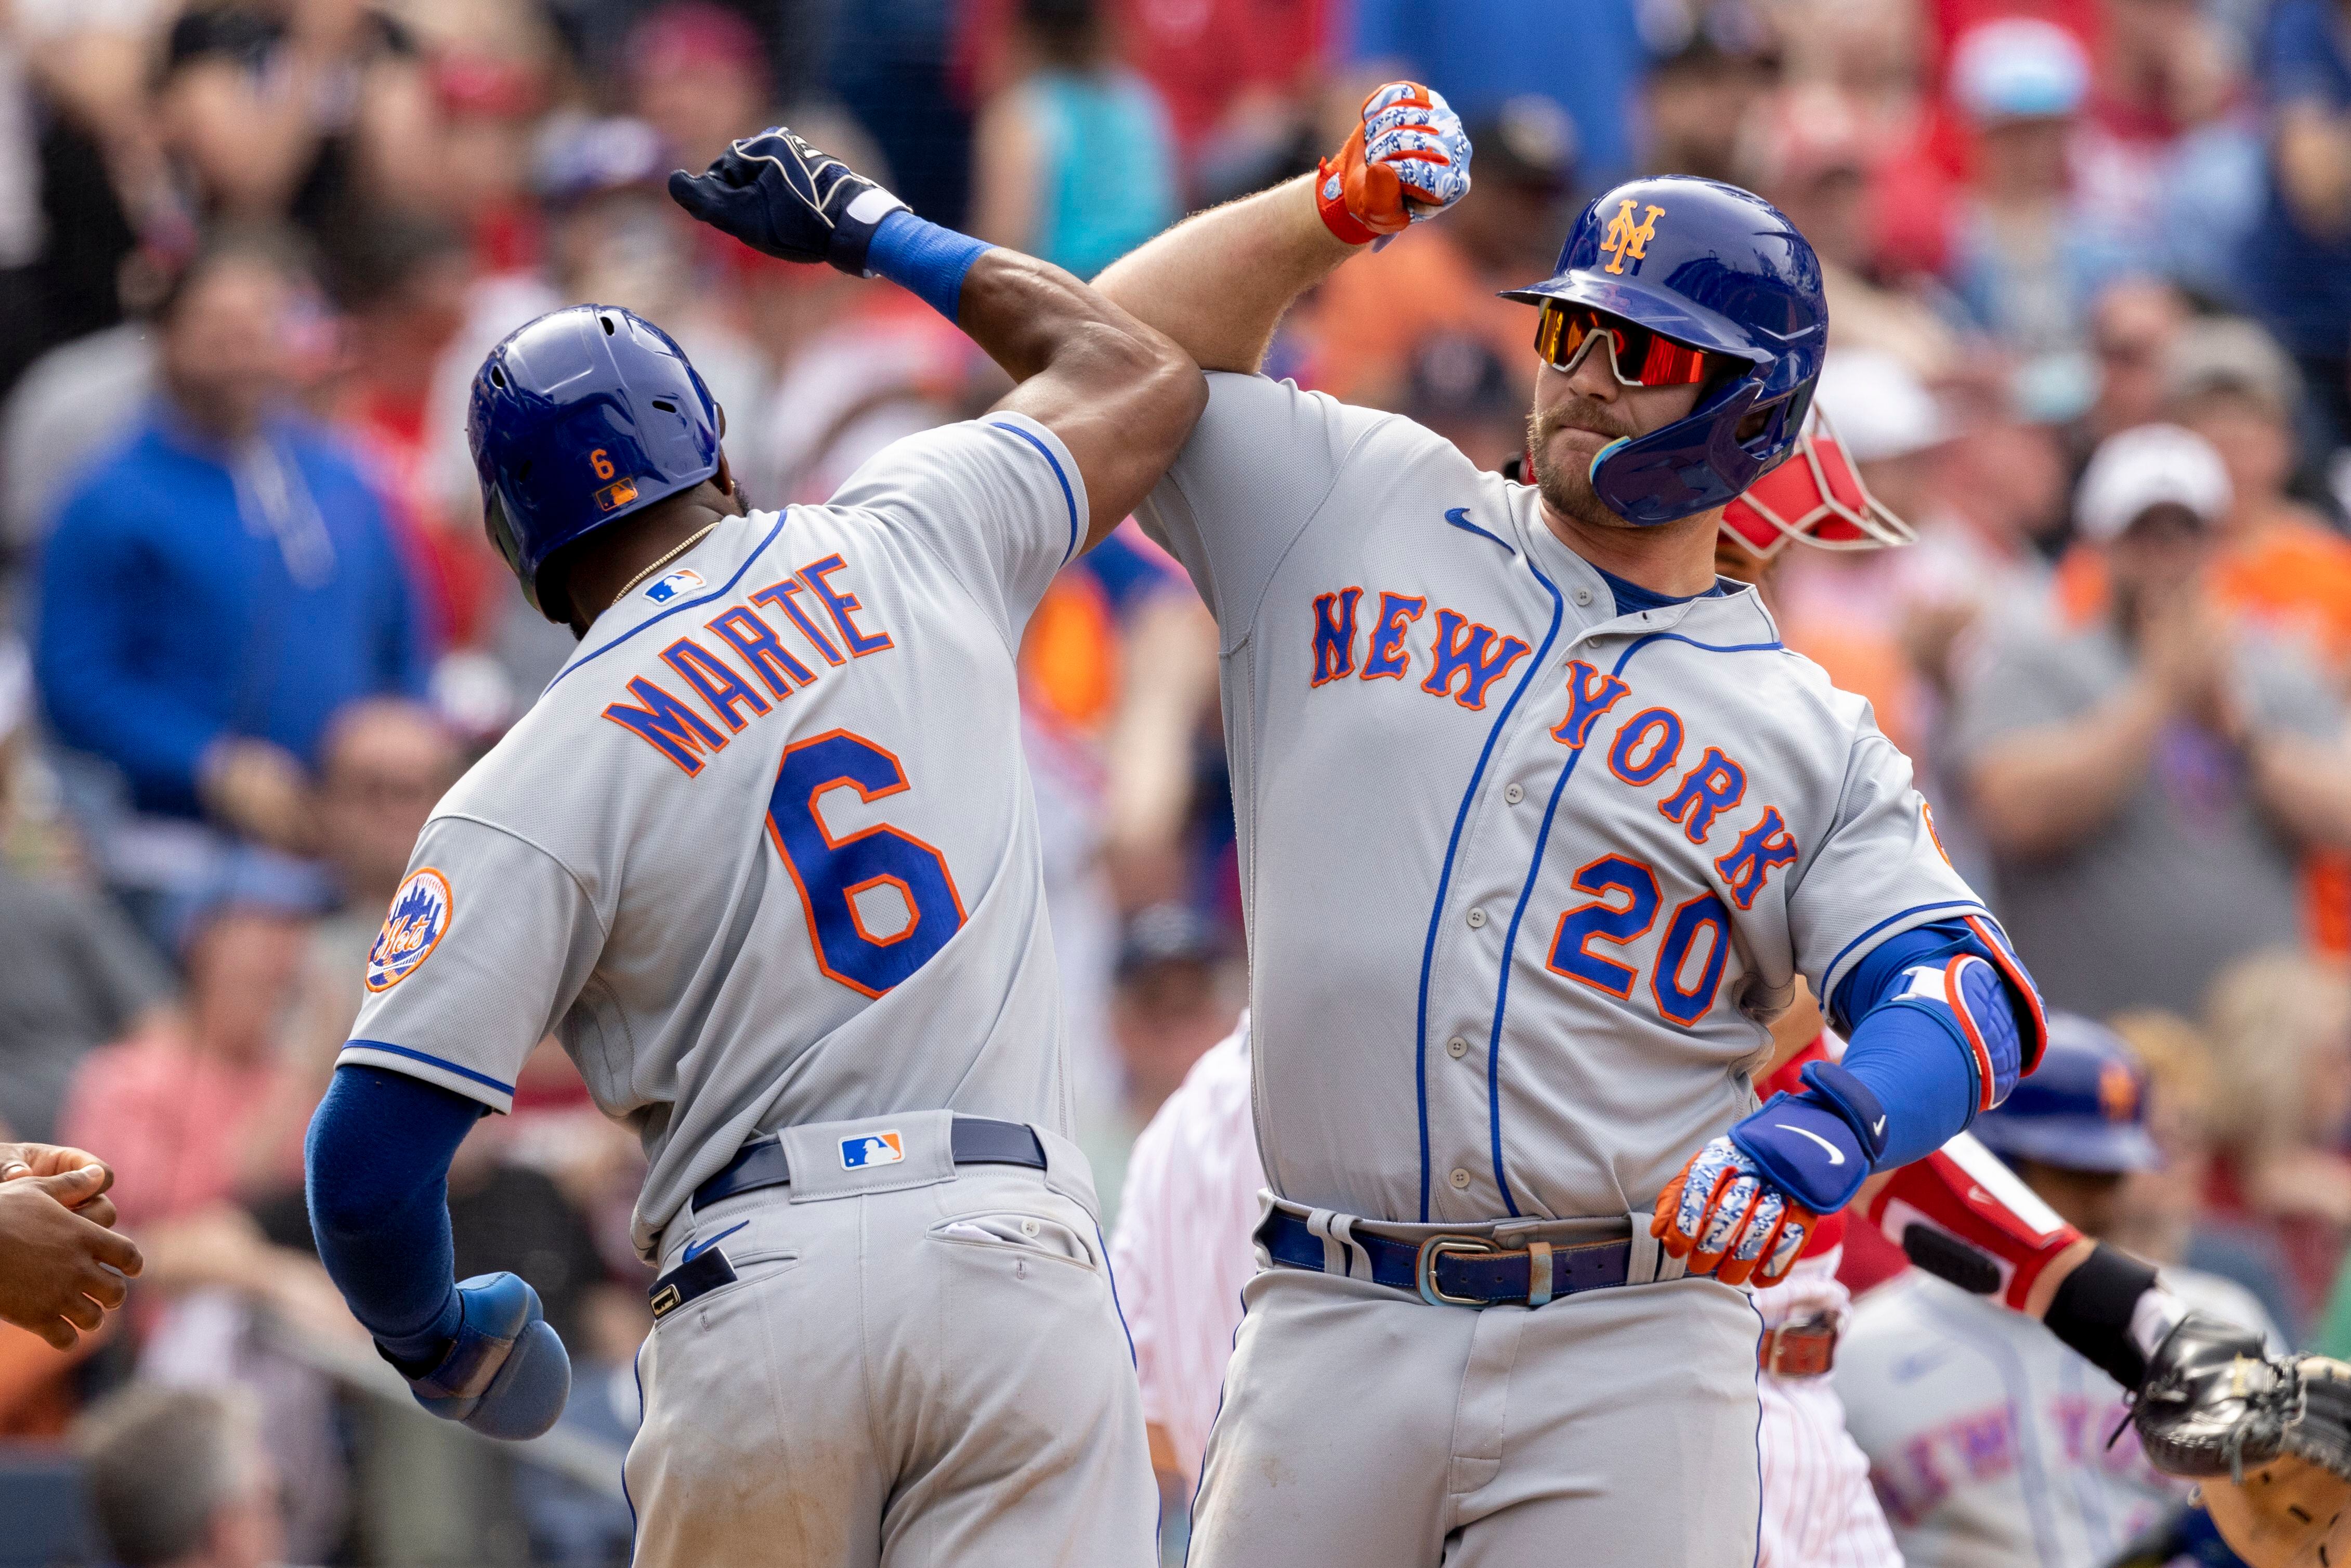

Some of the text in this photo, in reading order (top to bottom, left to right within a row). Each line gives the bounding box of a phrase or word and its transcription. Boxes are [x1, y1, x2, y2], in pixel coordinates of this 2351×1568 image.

[591, 449, 614, 480] 6
[602, 553, 894, 778] MARTE
[1310, 586, 1798, 910] NEW YORK
[375, 914, 431, 962] Mets
[766, 728, 967, 999] 6
[1547, 853, 1731, 1027] 20
